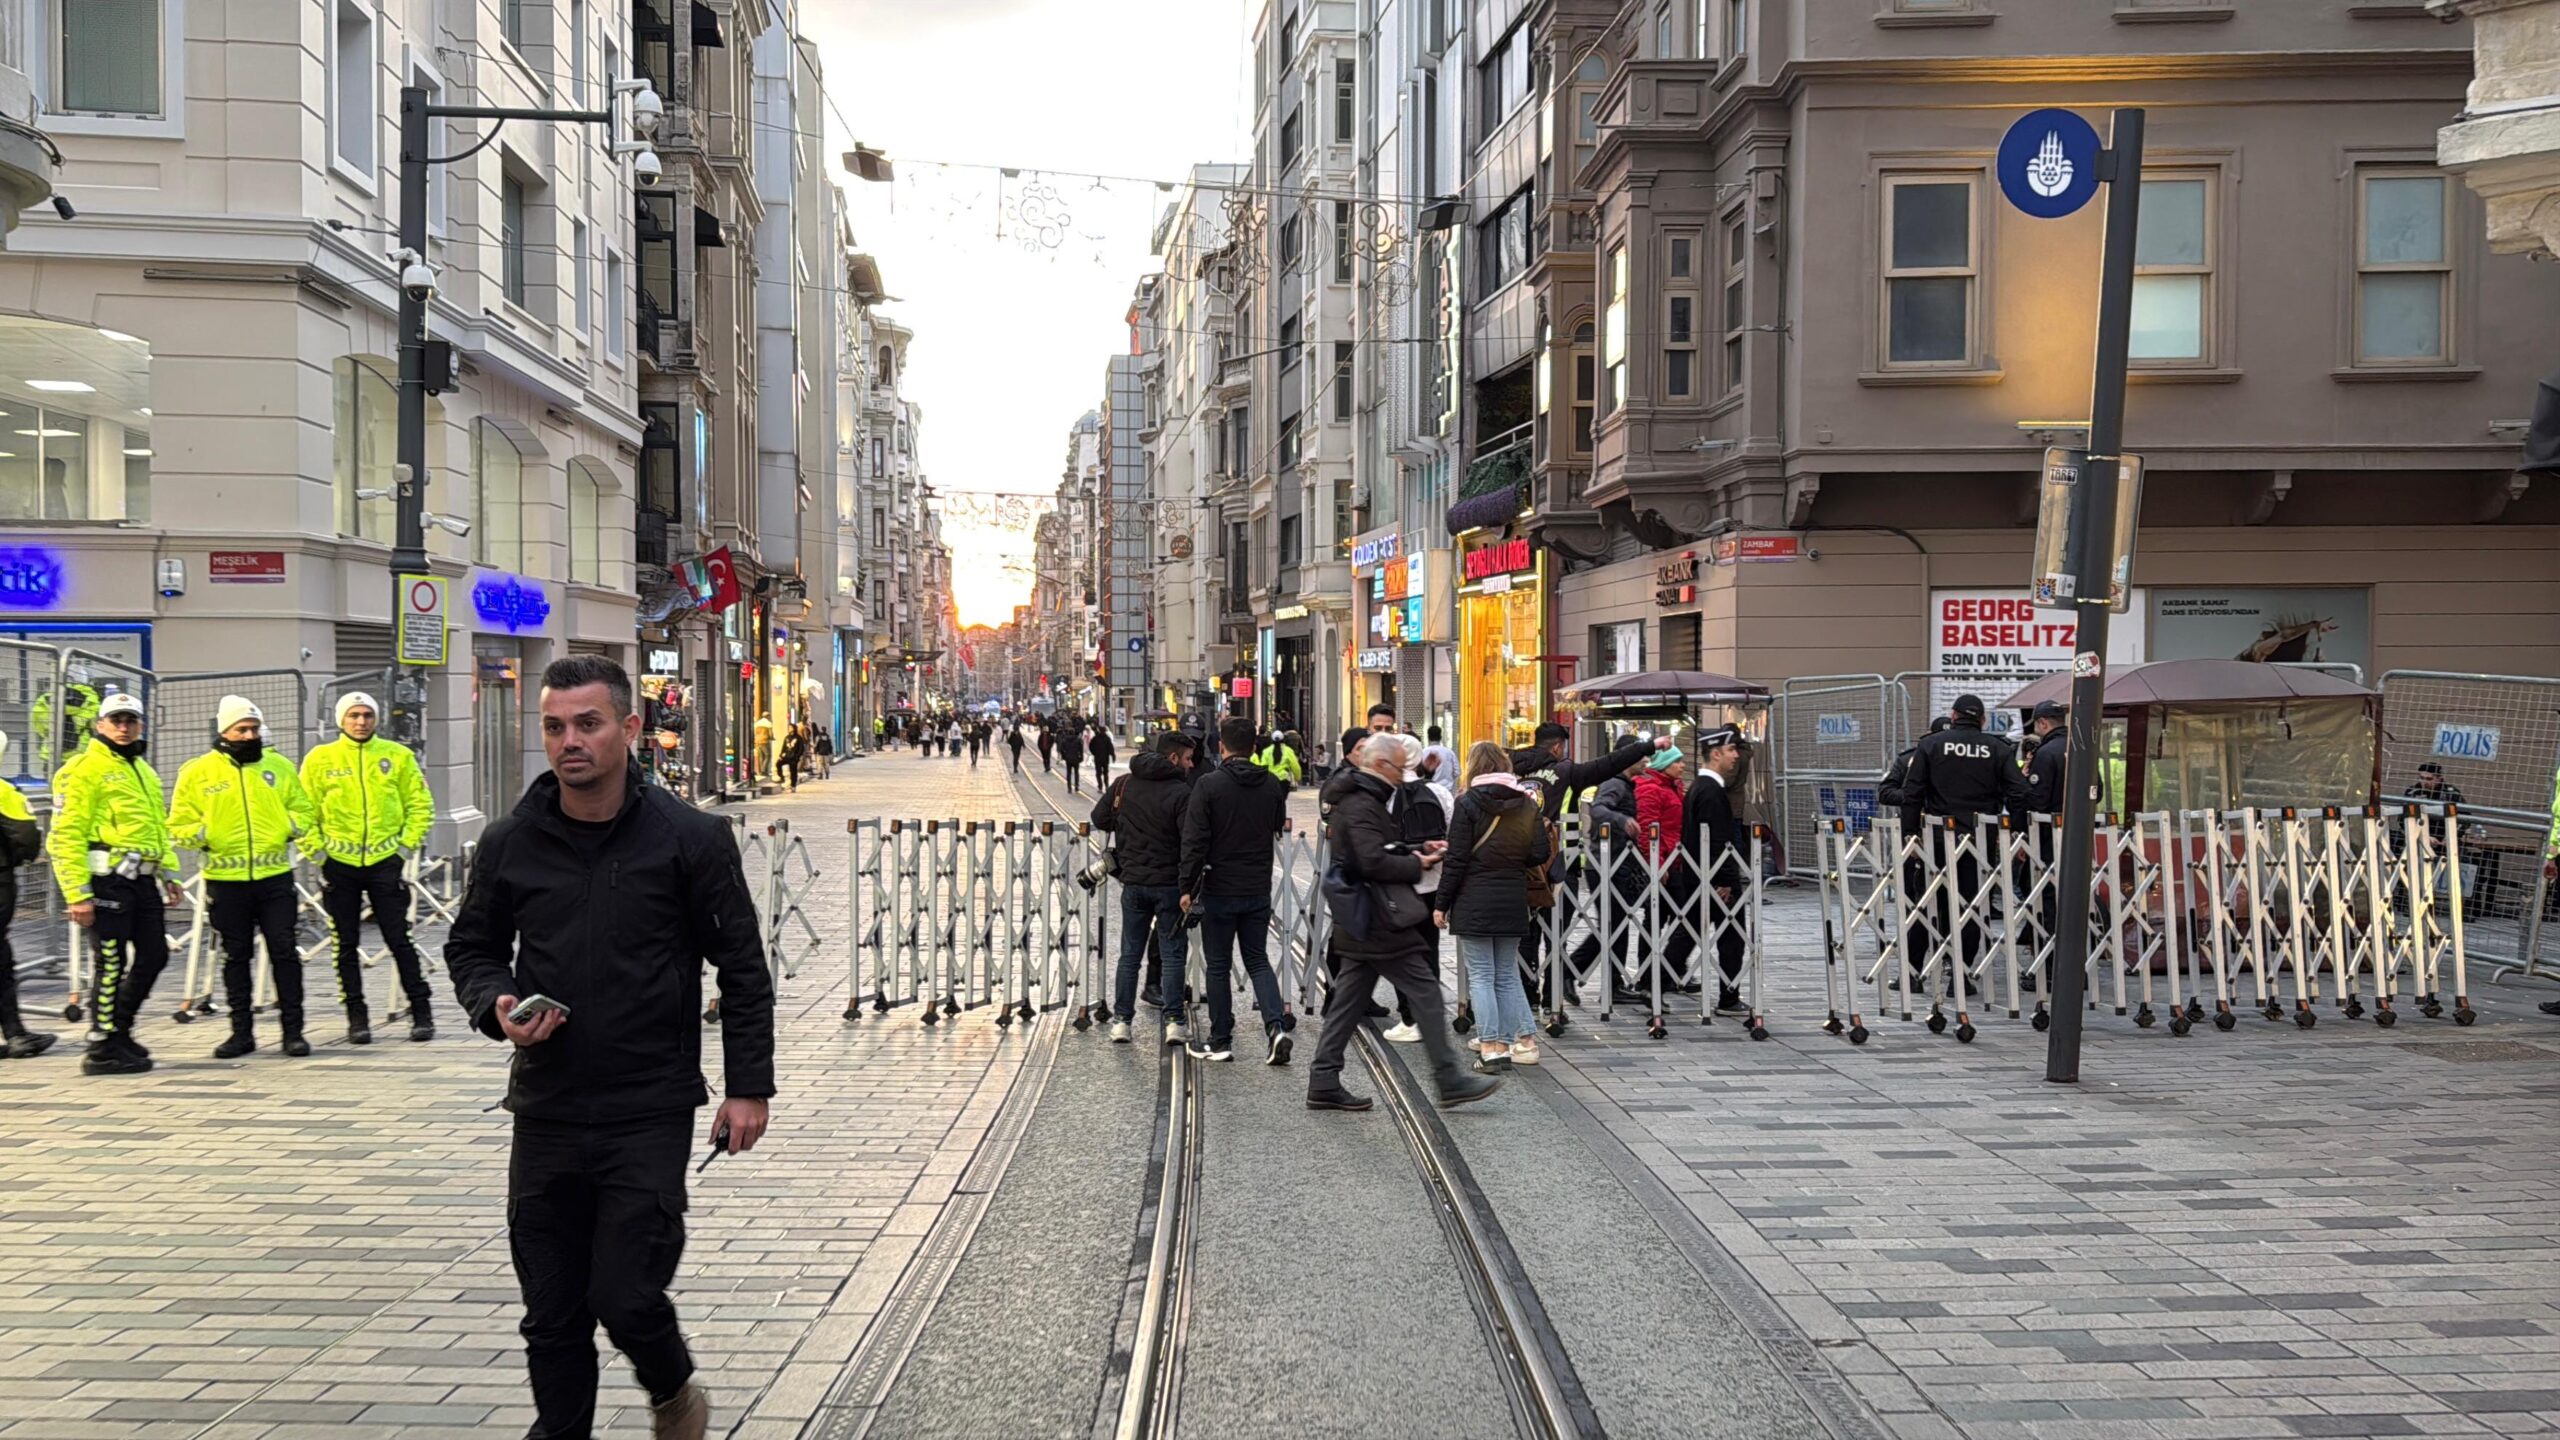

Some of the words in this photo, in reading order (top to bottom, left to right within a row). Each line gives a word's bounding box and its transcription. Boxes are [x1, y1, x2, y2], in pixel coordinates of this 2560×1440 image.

[1743, 540, 1775, 548] ZAMBAK
[213, 555, 259, 566] MEŞELİK
[1657, 560, 1694, 585] AKBANK
[1942, 599, 2034, 621] GEORG
[1942, 625, 2075, 647] BASELITZ
[1942, 653, 1974, 666] SON
[1977, 653, 1999, 666] ON
[2002, 653, 2026, 666] YIL
[1821, 715, 1852, 734] POLİS
[2438, 729, 2492, 757] POLİS
